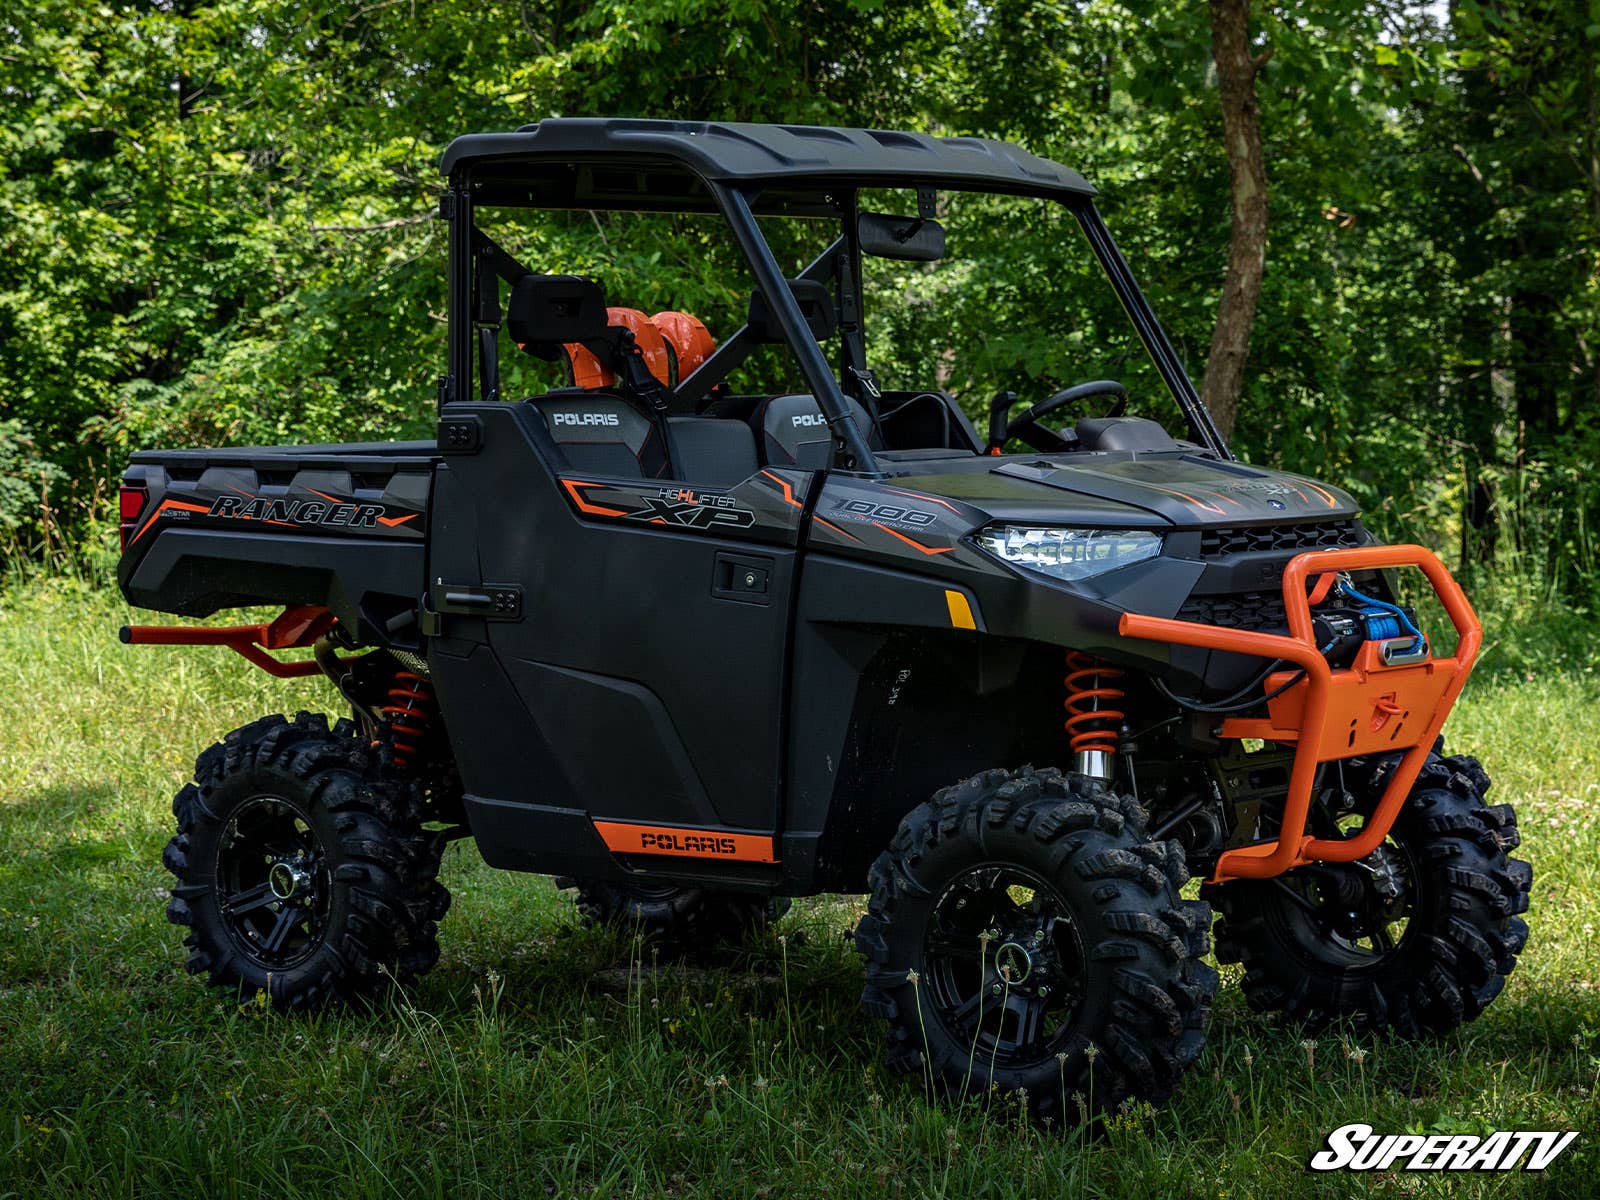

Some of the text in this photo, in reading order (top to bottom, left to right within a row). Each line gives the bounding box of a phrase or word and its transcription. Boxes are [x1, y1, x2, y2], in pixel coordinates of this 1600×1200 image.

[553, 413, 619, 426] POLARIS
[791, 414, 828, 428] POLA
[208, 496, 385, 528] RANGER
[622, 496, 756, 530] XP
[641, 833, 736, 853] POLARIS
